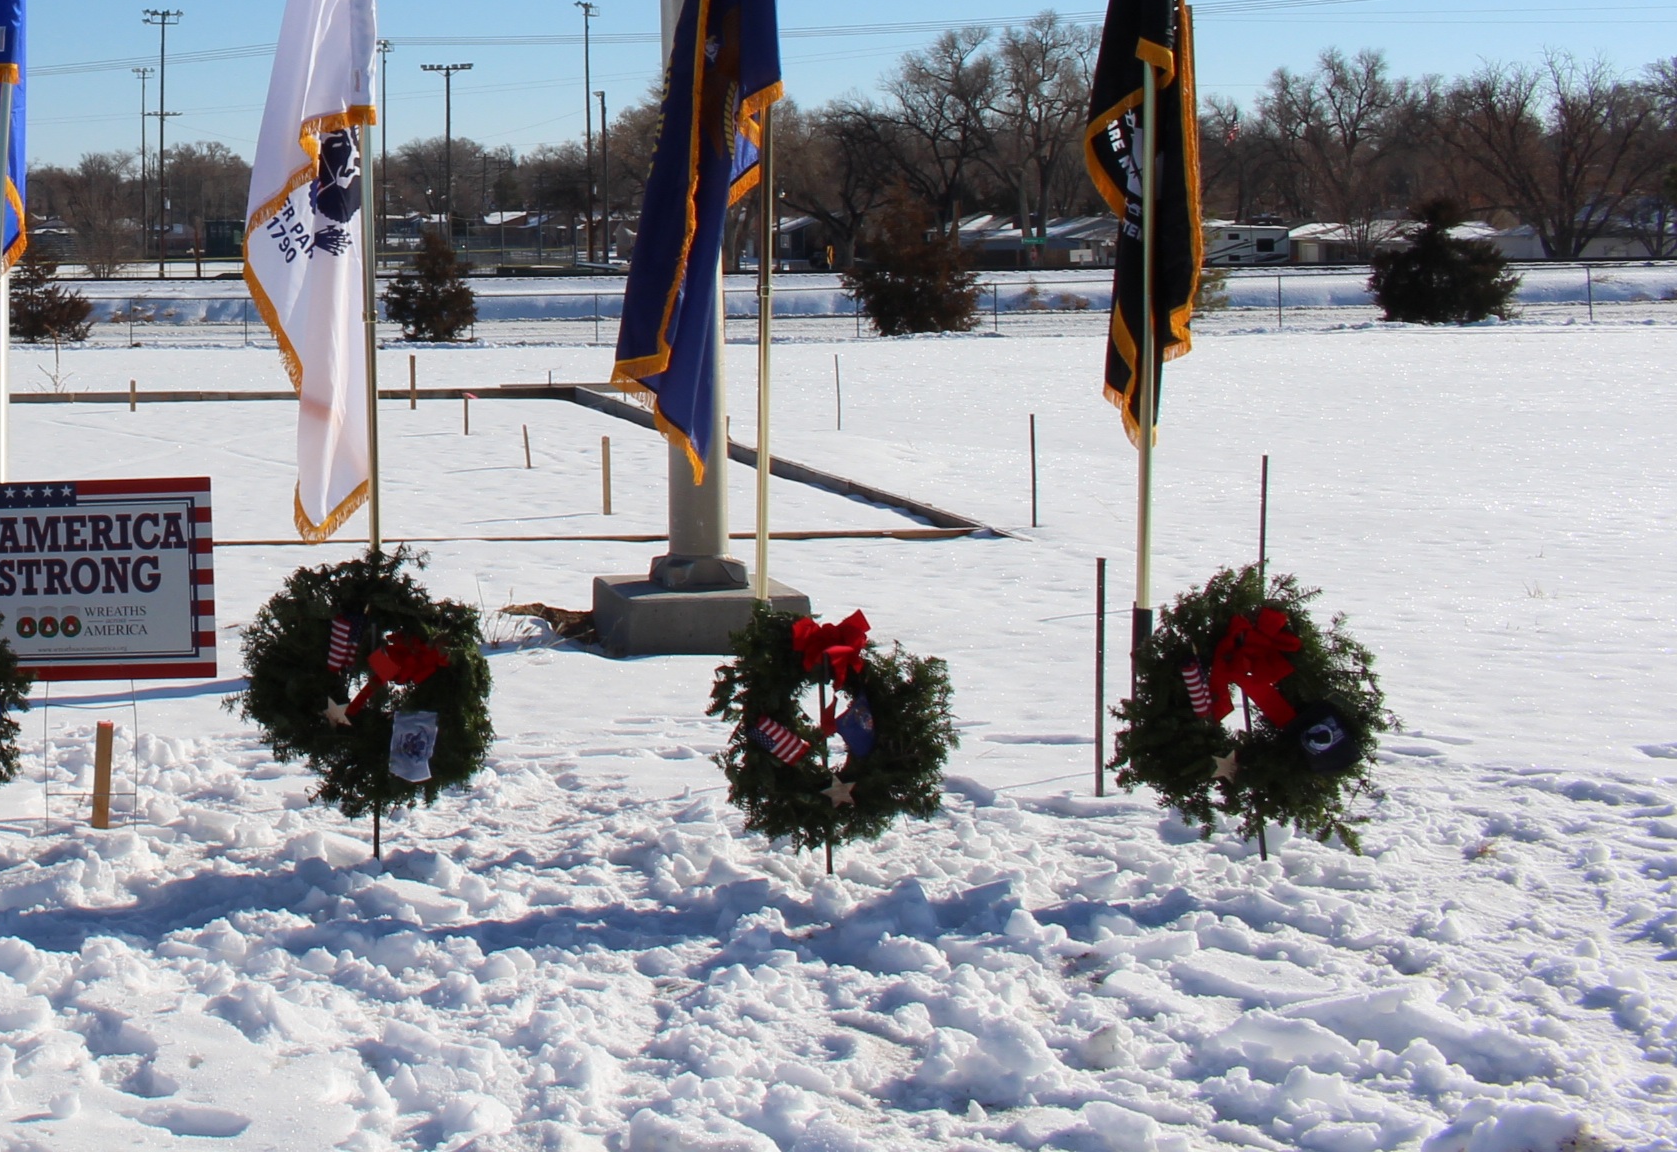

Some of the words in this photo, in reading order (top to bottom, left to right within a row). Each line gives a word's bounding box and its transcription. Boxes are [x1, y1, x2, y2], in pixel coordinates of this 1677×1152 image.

[267, 217, 296, 263] 1790
[84, 605, 147, 617] WREATHS
[84, 624, 148, 637] AMERICA
